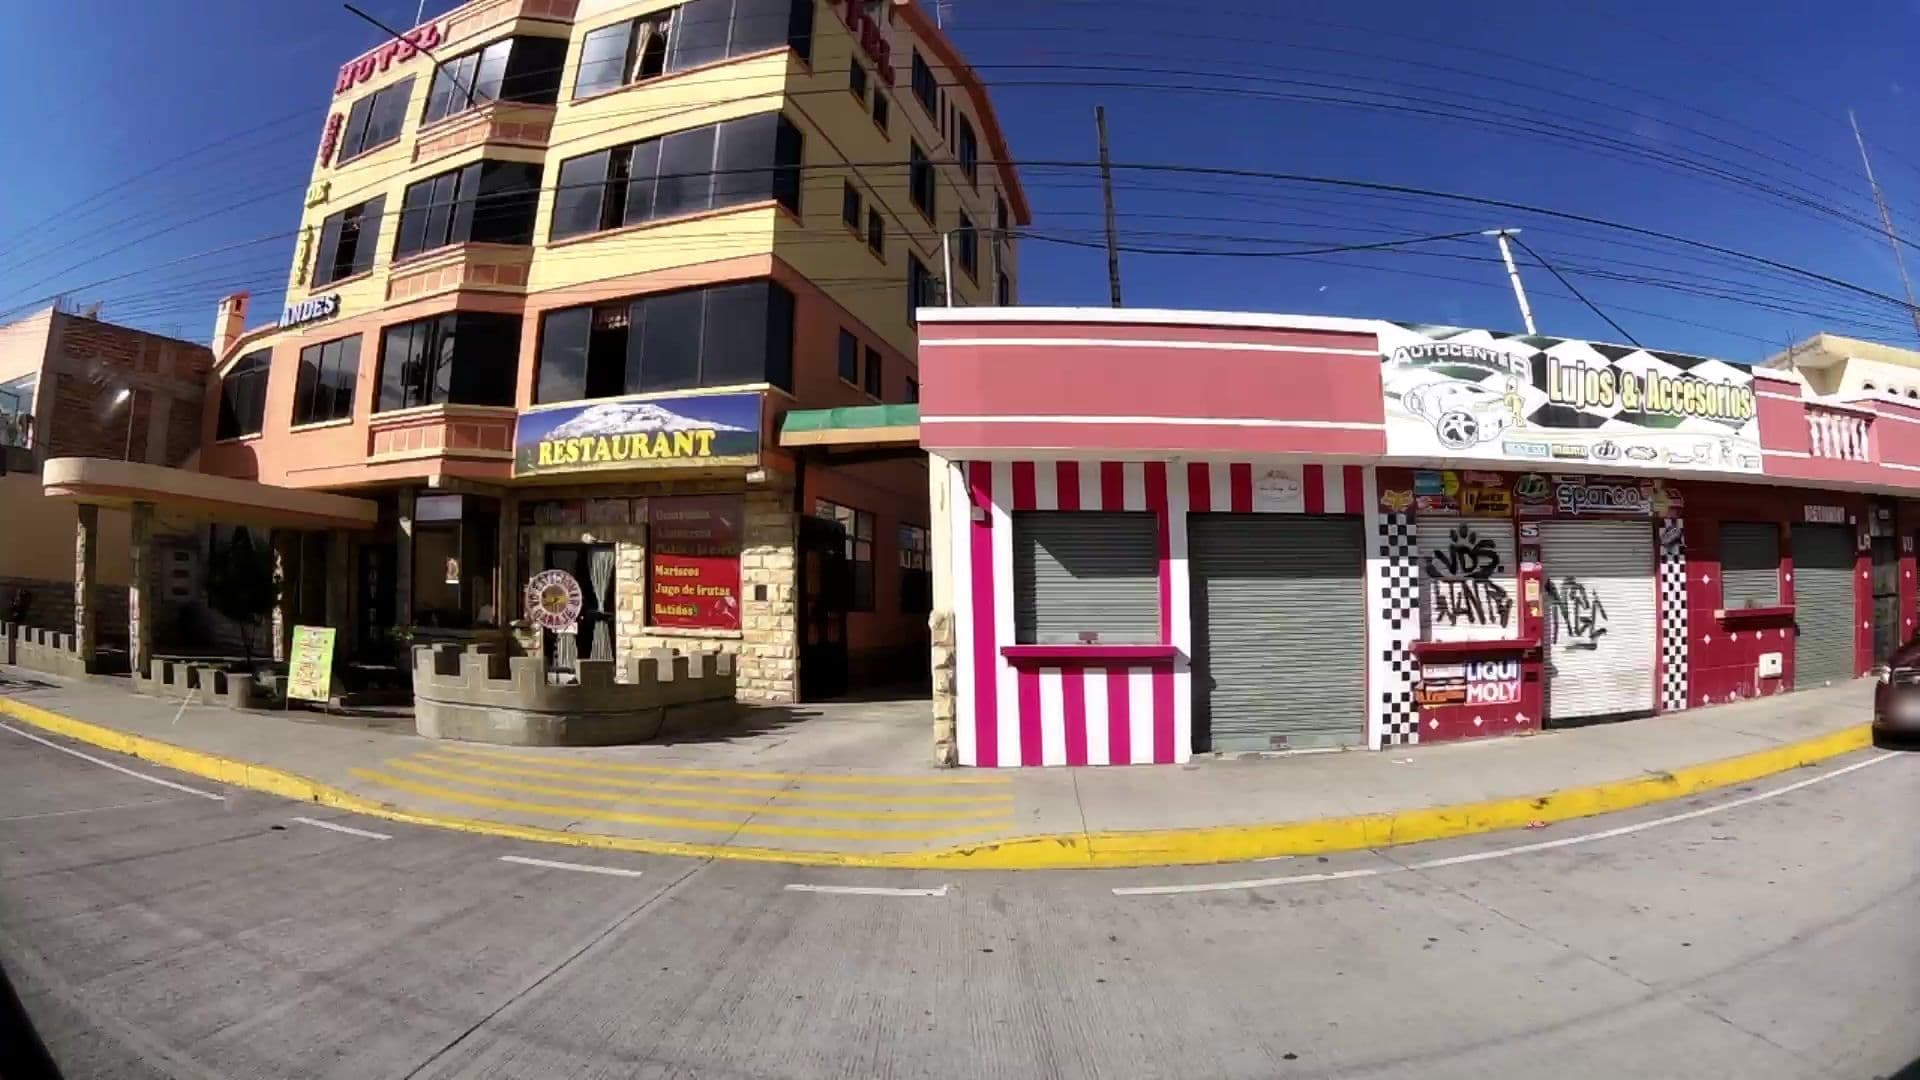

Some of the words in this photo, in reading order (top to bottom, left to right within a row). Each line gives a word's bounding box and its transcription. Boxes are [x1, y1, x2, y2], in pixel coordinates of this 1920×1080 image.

[335, 22, 441, 95] HOTEL
[279, 294, 341, 330] ANDES
[1392, 342, 1532, 382] AUTOCENTER
[1548, 356, 1615, 409] Lujos
[1621, 370, 1640, 411] &
[1646, 367, 1753, 419] Accesorios
[538, 430, 716, 466] RESTAURANT
[656, 564, 700, 577] Mariscos
[656, 583, 680, 597] Jugo
[682, 584, 695, 595] de
[697, 584, 731, 596] frutas
[656, 603, 694, 616] Batidos
[1467, 661, 1518, 681] LIQUI
[1466, 681, 1520, 703] MOLY
